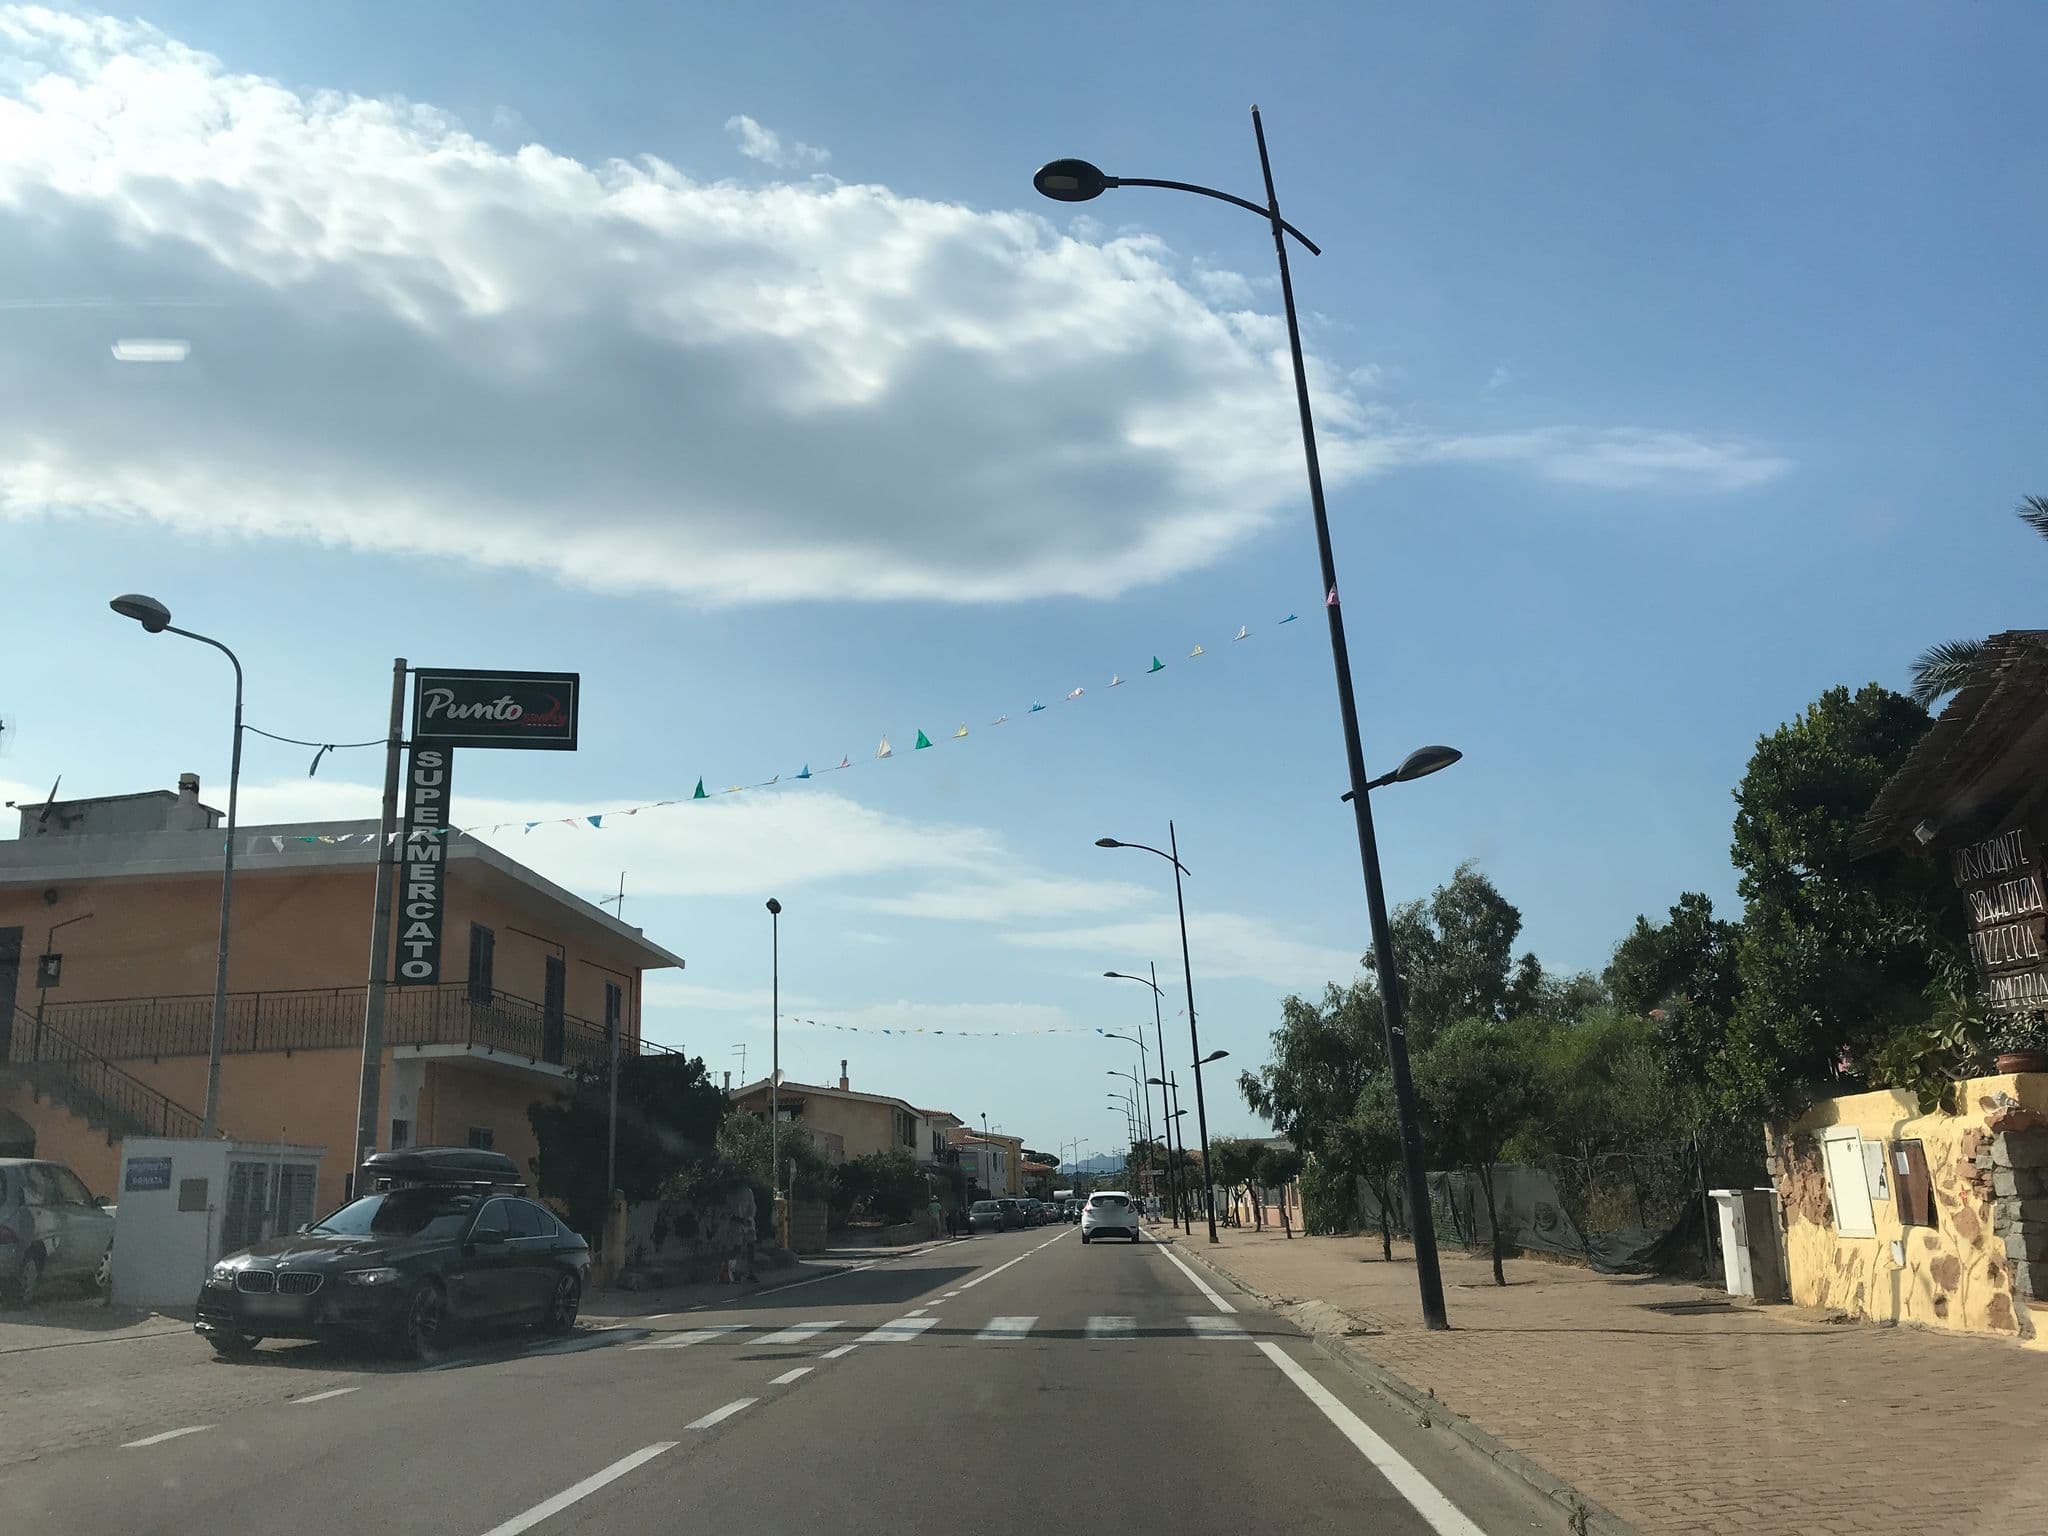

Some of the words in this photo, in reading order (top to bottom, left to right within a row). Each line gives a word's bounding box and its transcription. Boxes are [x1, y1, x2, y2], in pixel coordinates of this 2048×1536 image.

[424, 688, 523, 721] Punto
[401, 751, 443, 979] SUPERMERCATO
[1975, 925, 2040, 965] PIZZERIA
